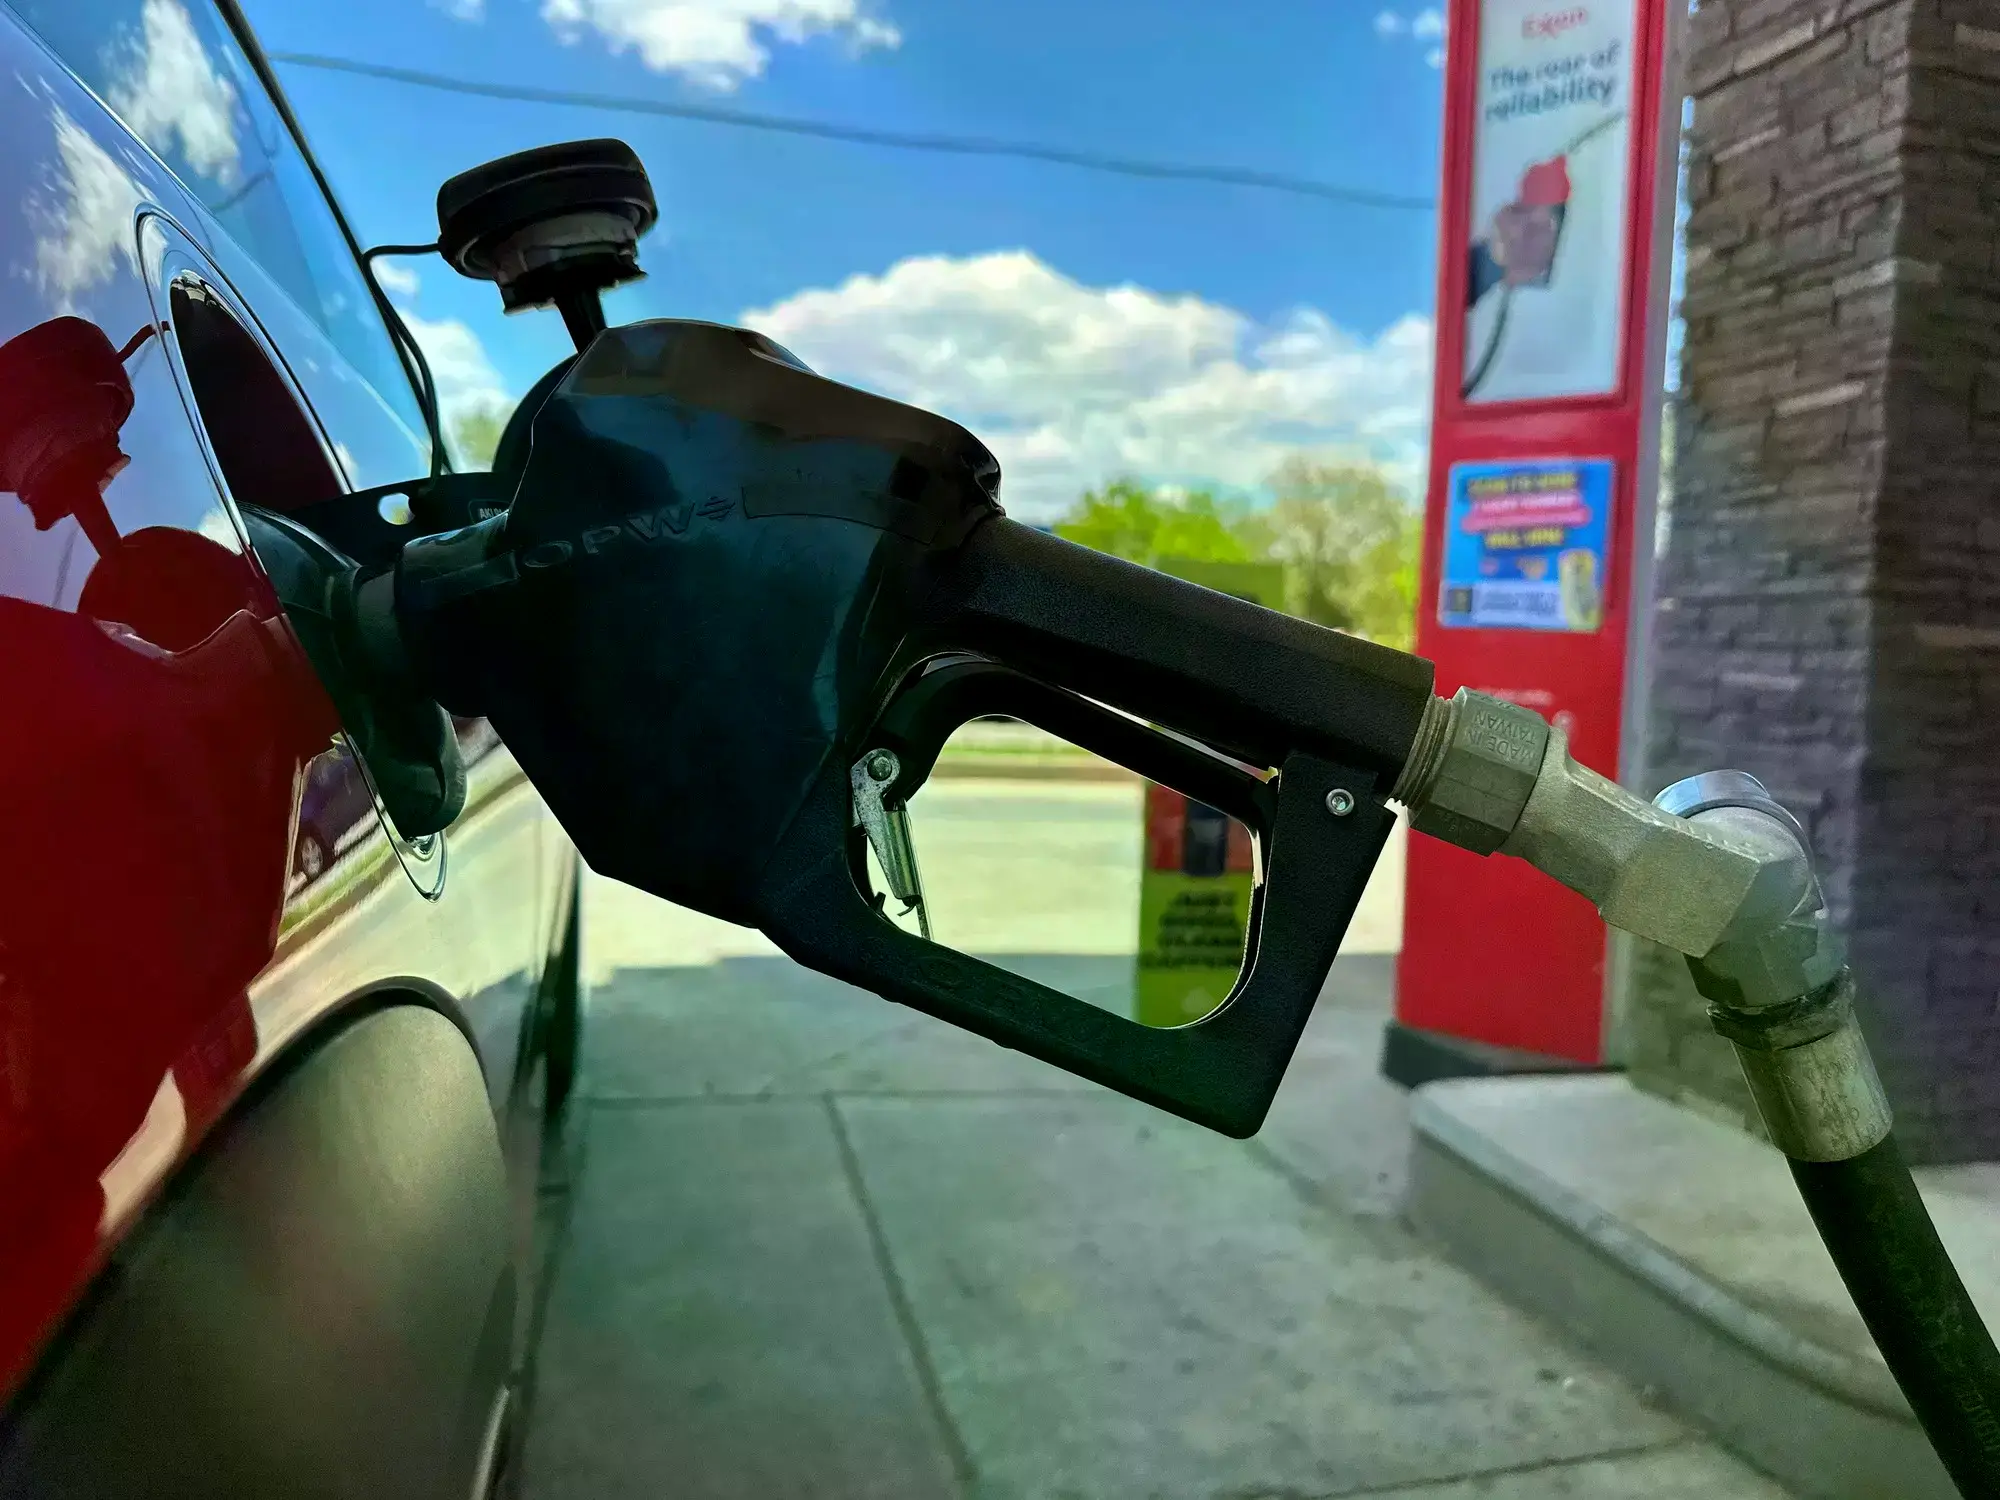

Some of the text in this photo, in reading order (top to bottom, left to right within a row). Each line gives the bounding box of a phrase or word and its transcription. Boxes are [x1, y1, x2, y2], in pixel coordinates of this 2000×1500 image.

[1490, 67, 1529, 91] The
[1485, 75, 1616, 121] reliability
[523, 501, 697, 568] OPW
[1468, 728, 1536, 763] MADE IN
[1474, 710, 1536, 746] TAIWAN
